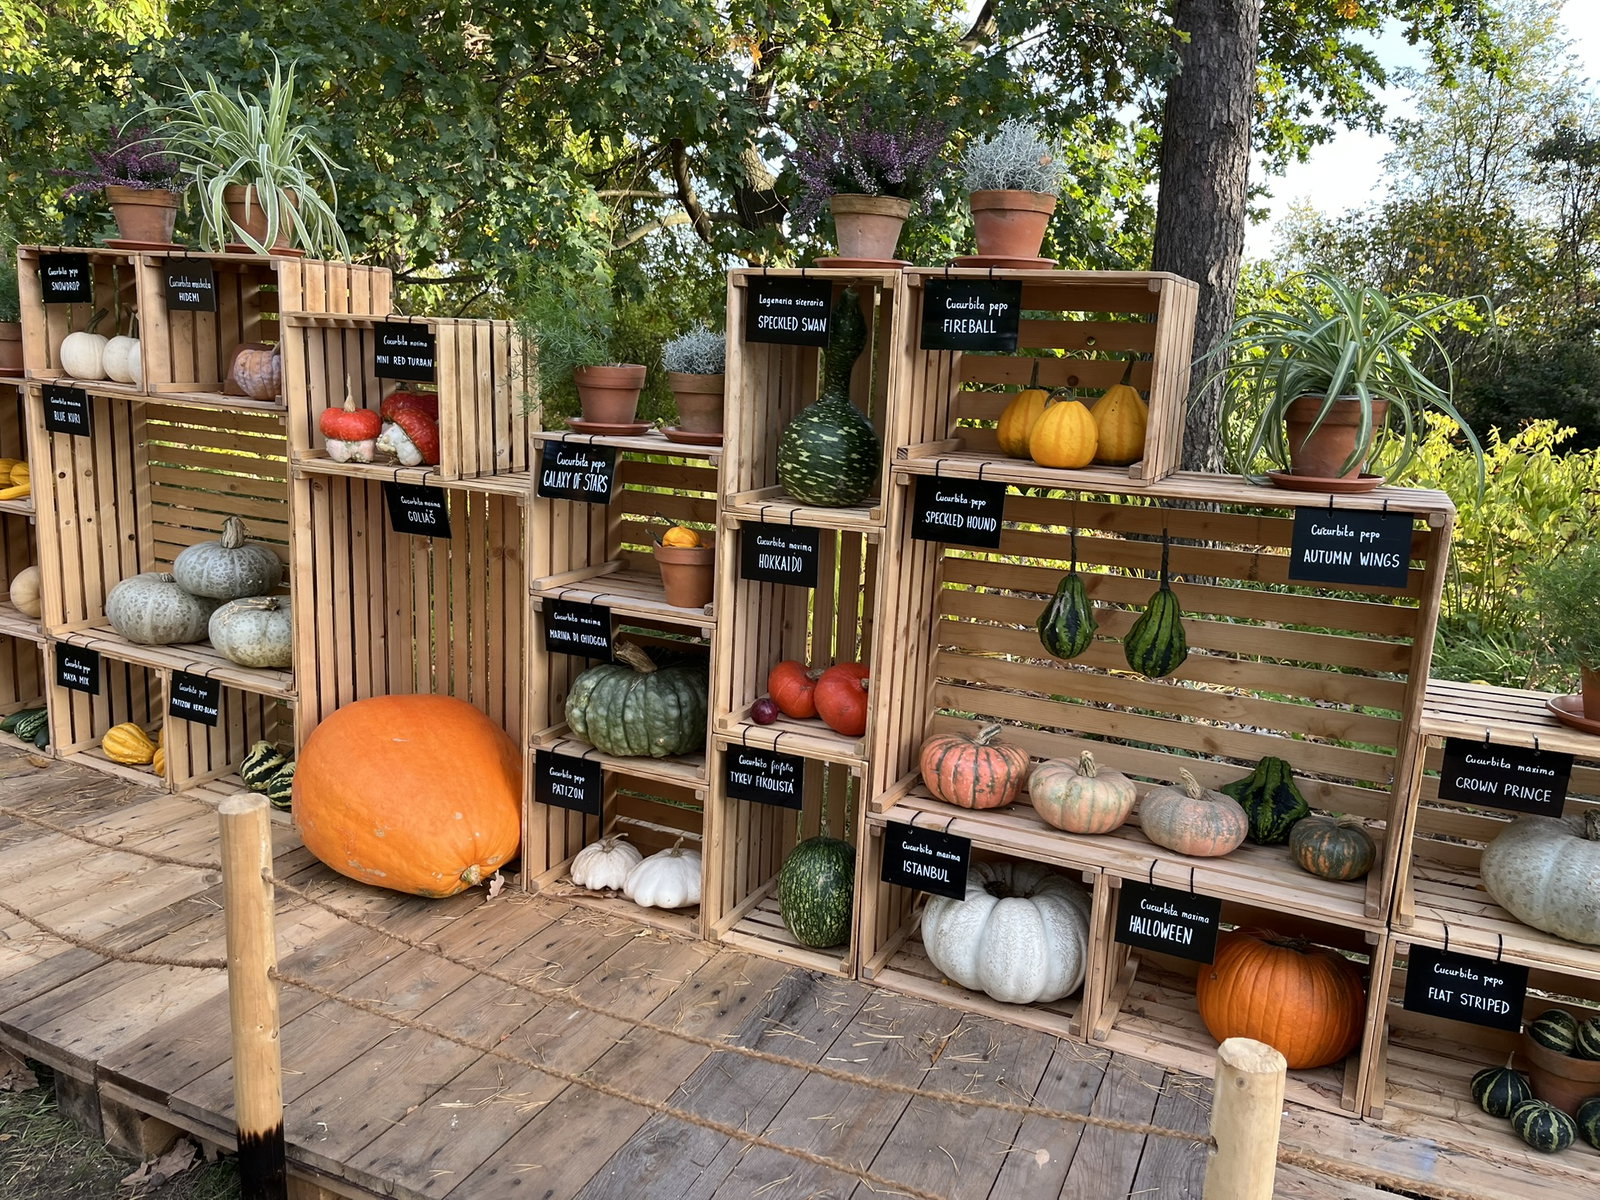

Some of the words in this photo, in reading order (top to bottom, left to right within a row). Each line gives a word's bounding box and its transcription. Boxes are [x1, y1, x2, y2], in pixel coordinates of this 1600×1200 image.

[51, 281, 80, 291] SNOWDROP
[759, 294, 792, 307] Lagenaria
[795, 298, 824, 307] siceraria
[946, 296, 985, 310] Cucurbita
[989, 302, 1008, 317] pepo
[758, 315, 799, 331] SPECKLED
[801, 317, 827, 333] SWAN
[943, 319, 997, 334] FIREBALL
[383, 335, 408, 346] Cucurbita
[376, 355, 390, 364] MINI
[393, 356, 406, 365] RED
[407, 356, 433, 368] TURBAN
[53, 410, 66, 422] BLUE
[67, 412, 81, 424] KURI
[557, 452, 589, 467] Cucurbita
[590, 460, 606, 474] pepo
[543, 470, 572, 489] GALAXY
[572, 472, 583, 490] OF
[583, 473, 609, 493] STARS
[400, 496, 424, 506] Cucurbita
[935, 491, 968, 504] Cucurbita
[972, 499, 987, 510] pepo
[925, 511, 964, 528] SPECKLED
[966, 515, 997, 532] HOUND
[756, 536, 785, 549] Cucurbita
[1311, 524, 1354, 537] Cucurbita
[1359, 530, 1380, 543] pepo
[758, 554, 803, 572] HOKKAIDO
[1303, 549, 1352, 565] AUTUMN
[1359, 551, 1400, 568] WINGS
[553, 612, 578, 623] Cucurbita
[549, 629, 571, 641] MARINA
[572, 632, 579, 643] DI
[63, 672, 77, 682] MAYA
[78, 675, 90, 686] MIX
[172, 697, 191, 709] PATIZON
[738, 754, 767, 769] Cucurbita
[1465, 754, 1511, 769] Cucurbita
[1517, 764, 1555, 776] maxima
[573, 775, 586, 785] pepo
[730, 771, 753, 785] TYKEV
[755, 772, 795, 794] FÍKOLISTÁ
[552, 782, 585, 800] PATIZON
[1455, 776, 1498, 794] CROWN
[1503, 783, 1552, 803] PRINCE
[902, 841, 933, 855] Cucurbita
[936, 851, 961, 863] maxima
[903, 860, 950, 883] ISTANBUL
[1140, 898, 1178, 917] Cucurbita
[1181, 911, 1209, 924] maxima
[1129, 915, 1193, 945] HALLOWEEN
[1434, 963, 1479, 981] Cucurbita
[1483, 975, 1504, 988] pepo
[1428, 987, 1454, 1003] FLAT
[1460, 993, 1510, 1015] STRIPED
